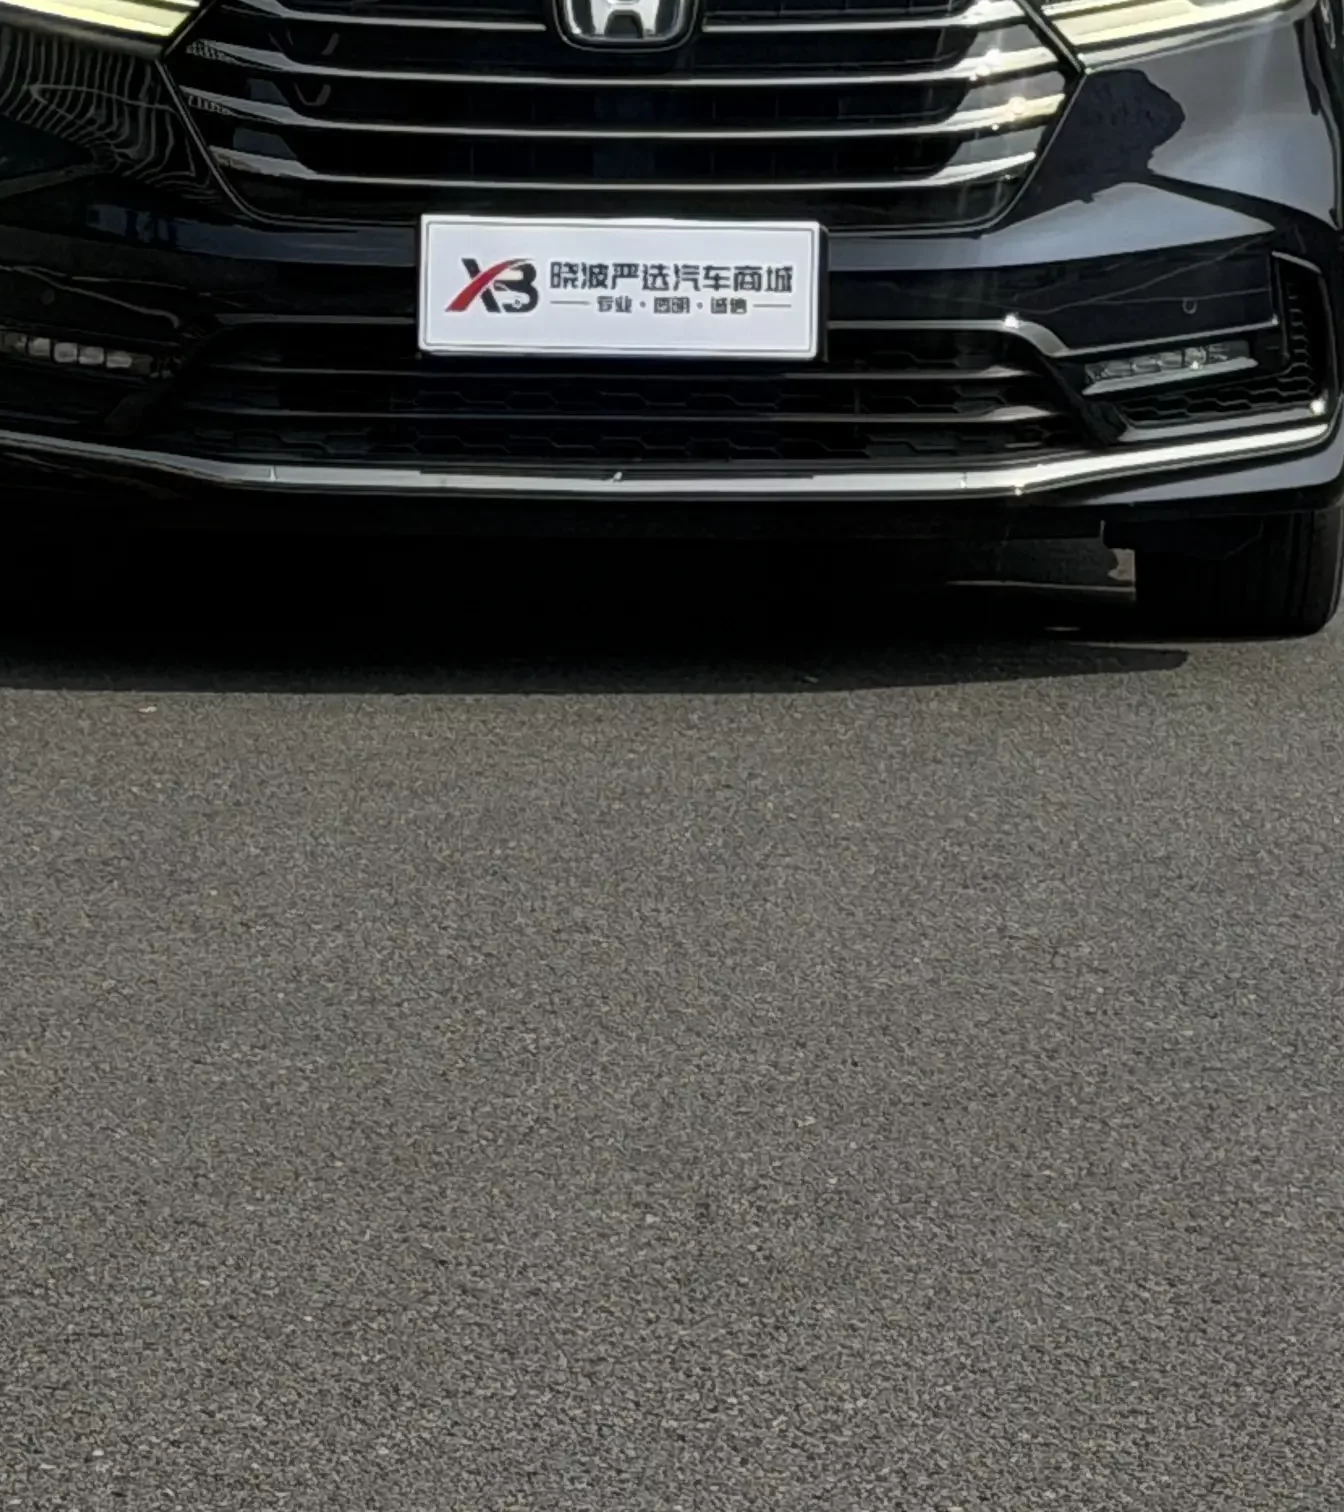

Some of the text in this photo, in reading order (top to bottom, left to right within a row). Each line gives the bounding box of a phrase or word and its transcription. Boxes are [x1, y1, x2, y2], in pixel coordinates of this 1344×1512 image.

[549, 261, 793, 293] 晓波严选汽车商城
